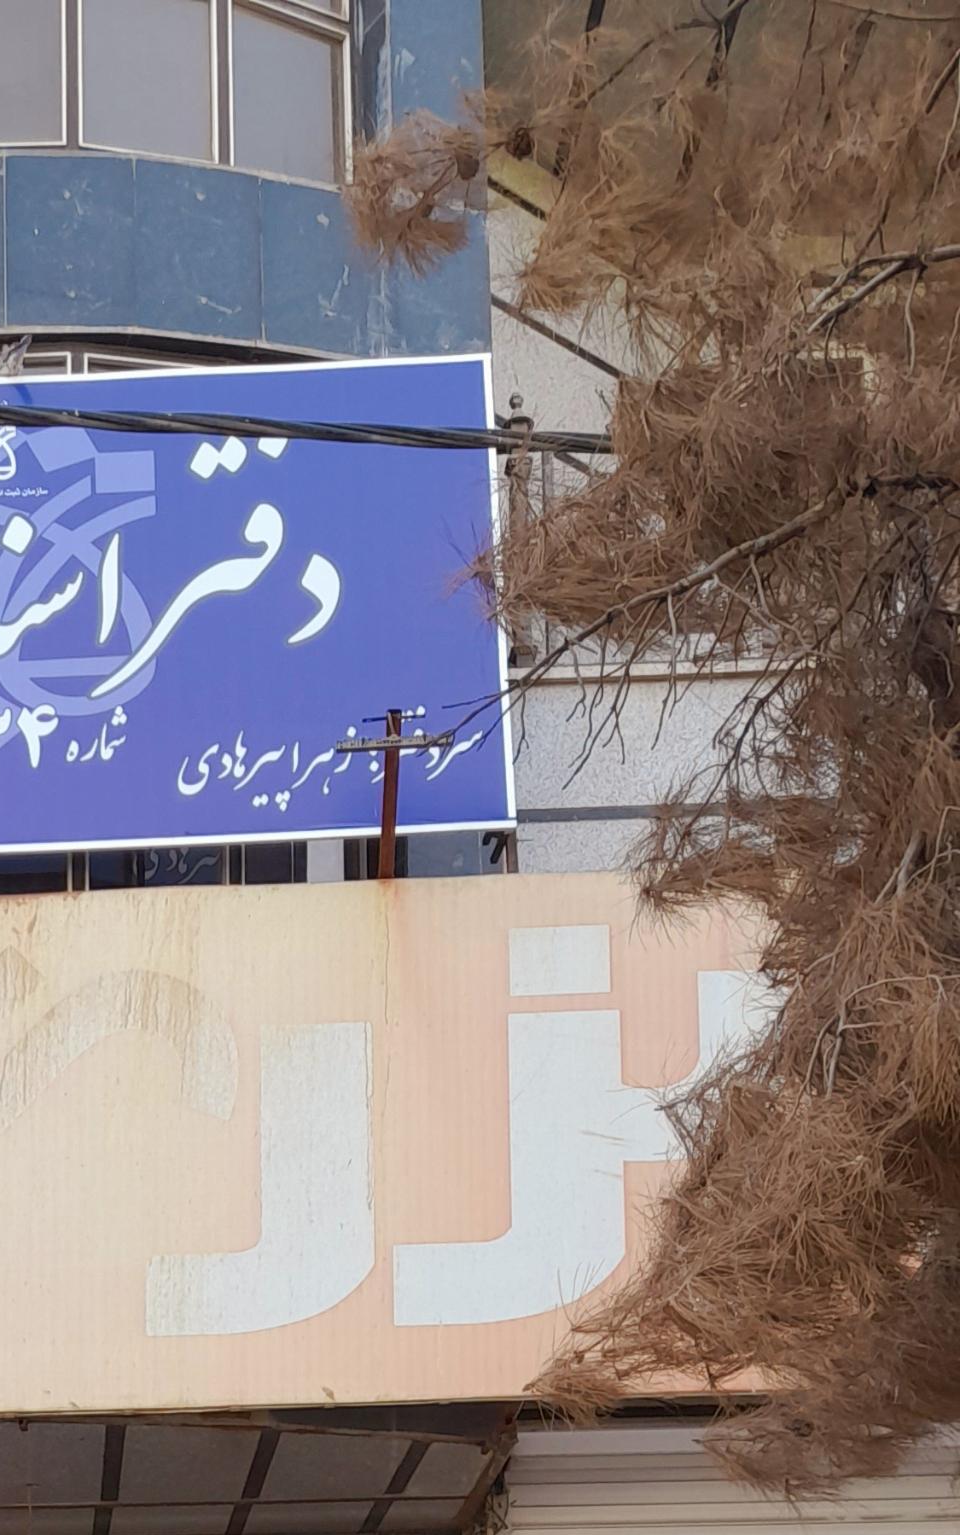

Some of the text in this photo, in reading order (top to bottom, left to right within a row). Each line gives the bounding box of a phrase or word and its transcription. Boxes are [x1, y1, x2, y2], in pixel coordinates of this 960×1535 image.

[5, 487, 21, 497] ثبت
[22, 486, 48, 498] سازمان
[91, 436, 341, 698] دفتر
[65, 704, 128, 762] شماره
